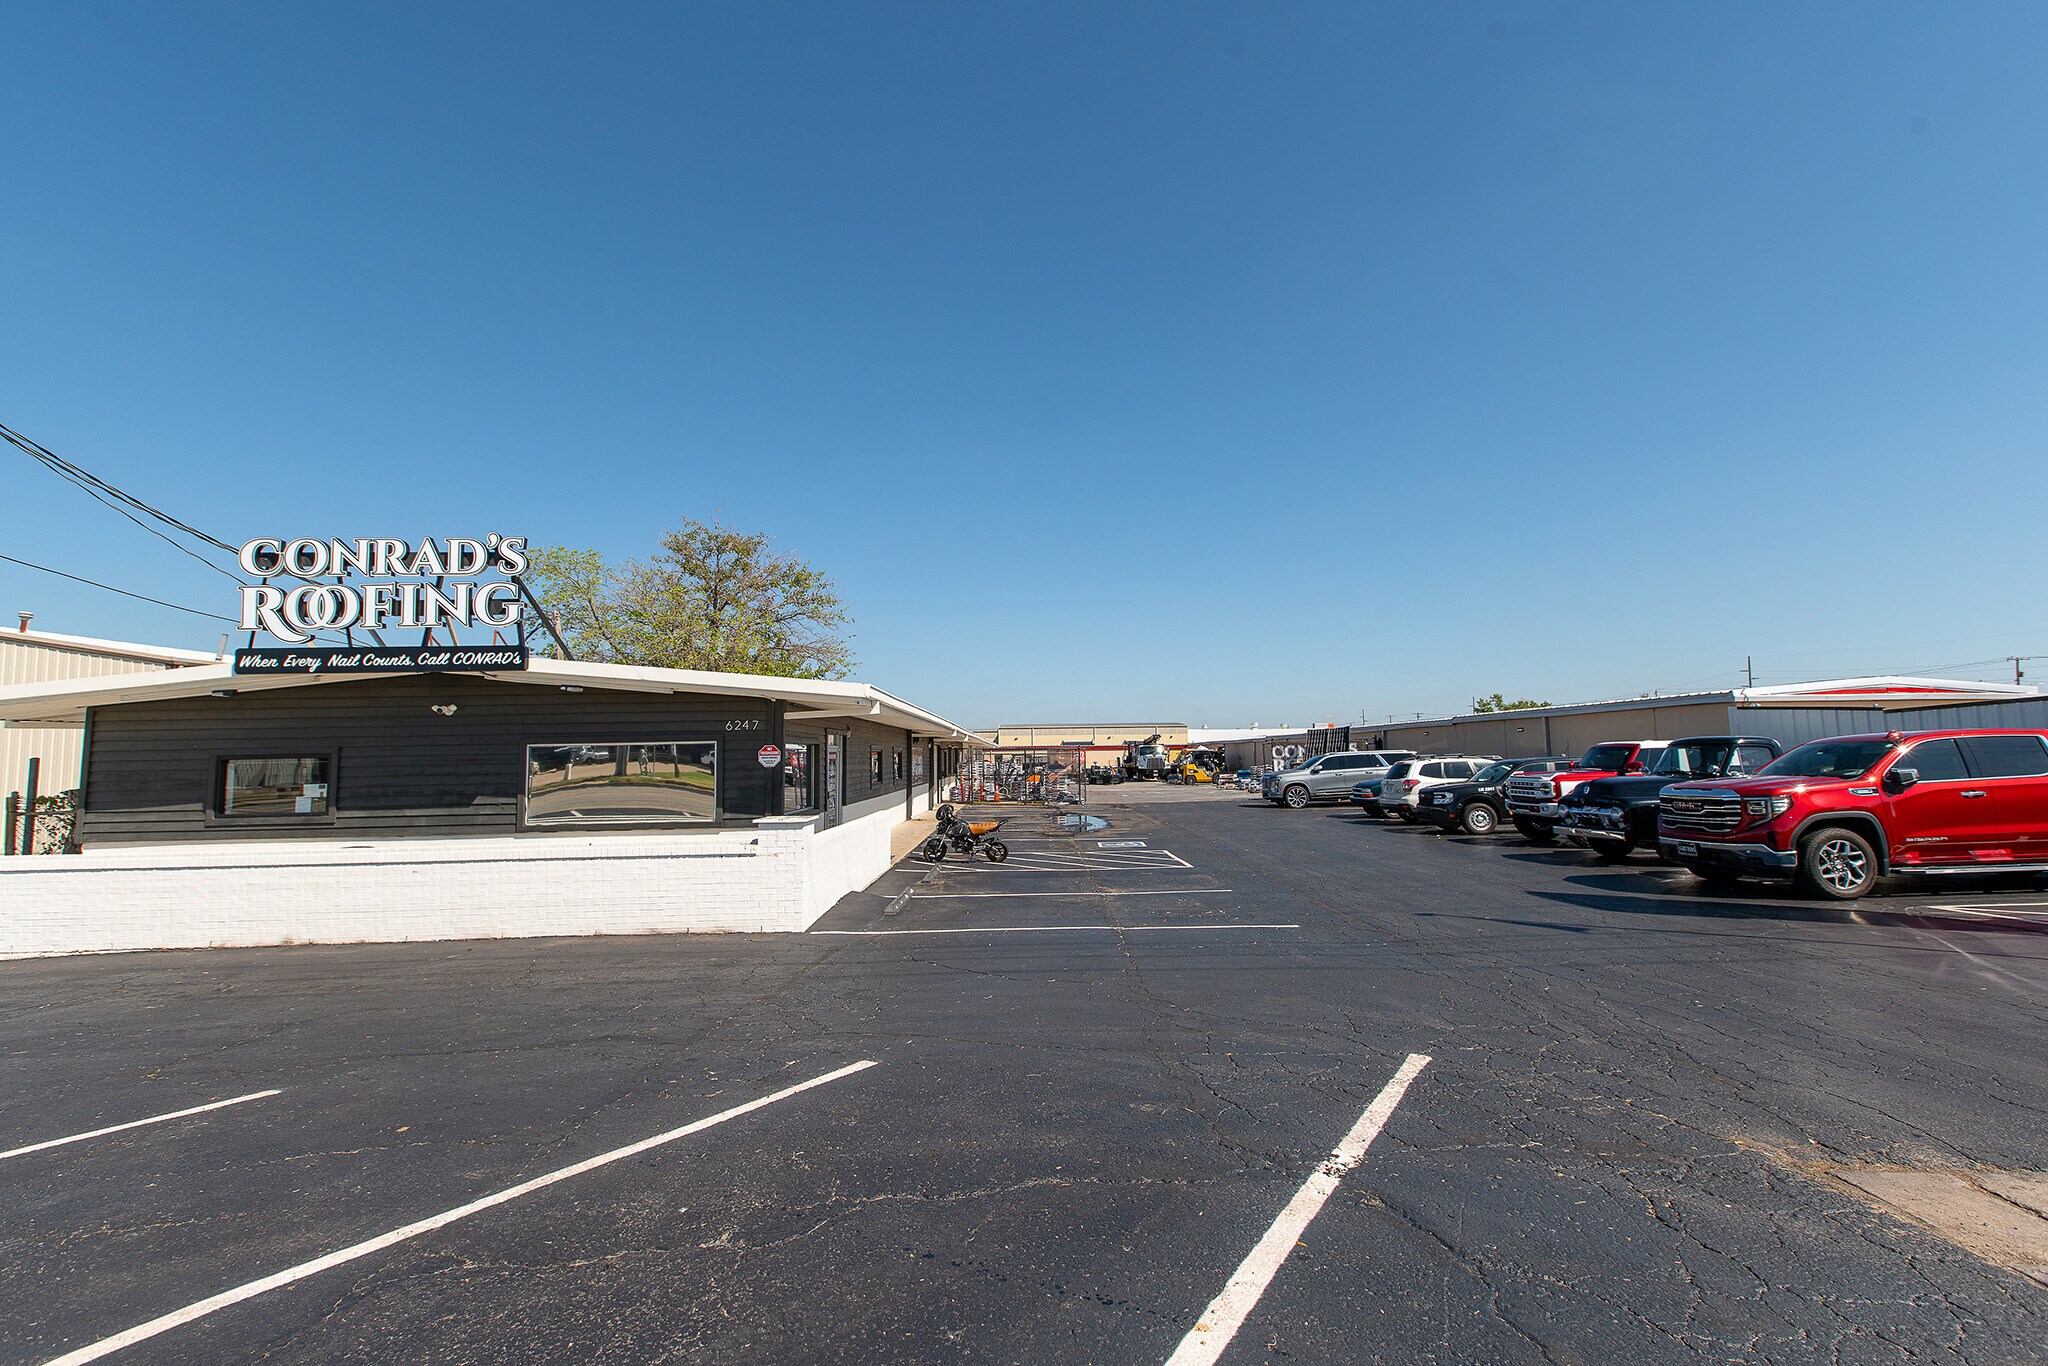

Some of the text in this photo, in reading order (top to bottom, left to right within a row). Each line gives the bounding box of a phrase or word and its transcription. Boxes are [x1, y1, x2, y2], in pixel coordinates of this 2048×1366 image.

[238, 532, 529, 578] CONRAD'S
[236, 581, 526, 644] ROOFING
[239, 654, 279, 668] When
[282, 654, 322, 673] Every
[327, 653, 361, 667] Nail
[417, 652, 450, 665] Call
[452, 651, 522, 665] CONRAD's
[725, 720, 759, 731] 6247
